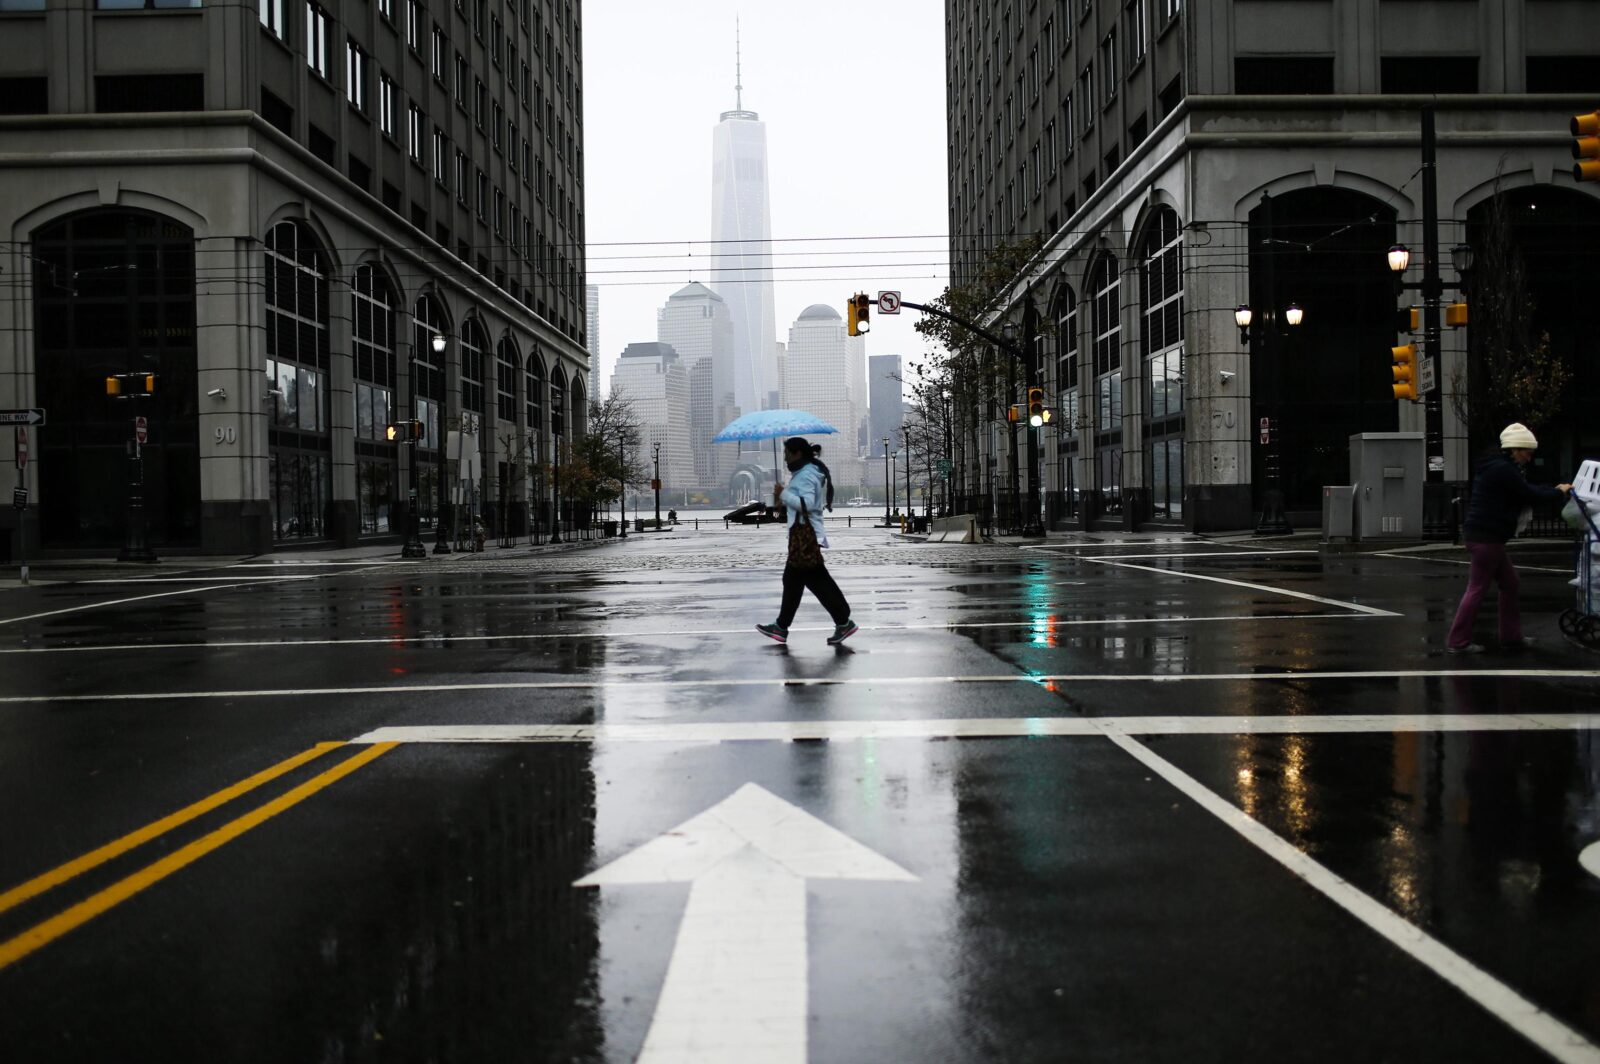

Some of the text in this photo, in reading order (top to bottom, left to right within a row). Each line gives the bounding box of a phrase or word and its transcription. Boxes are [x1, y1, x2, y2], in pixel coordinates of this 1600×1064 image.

[1421, 359, 1431, 369] LEFT
[15, 413, 28, 421] WAY
[1212, 409, 1235, 429] 70
[215, 426, 236, 445] 90
